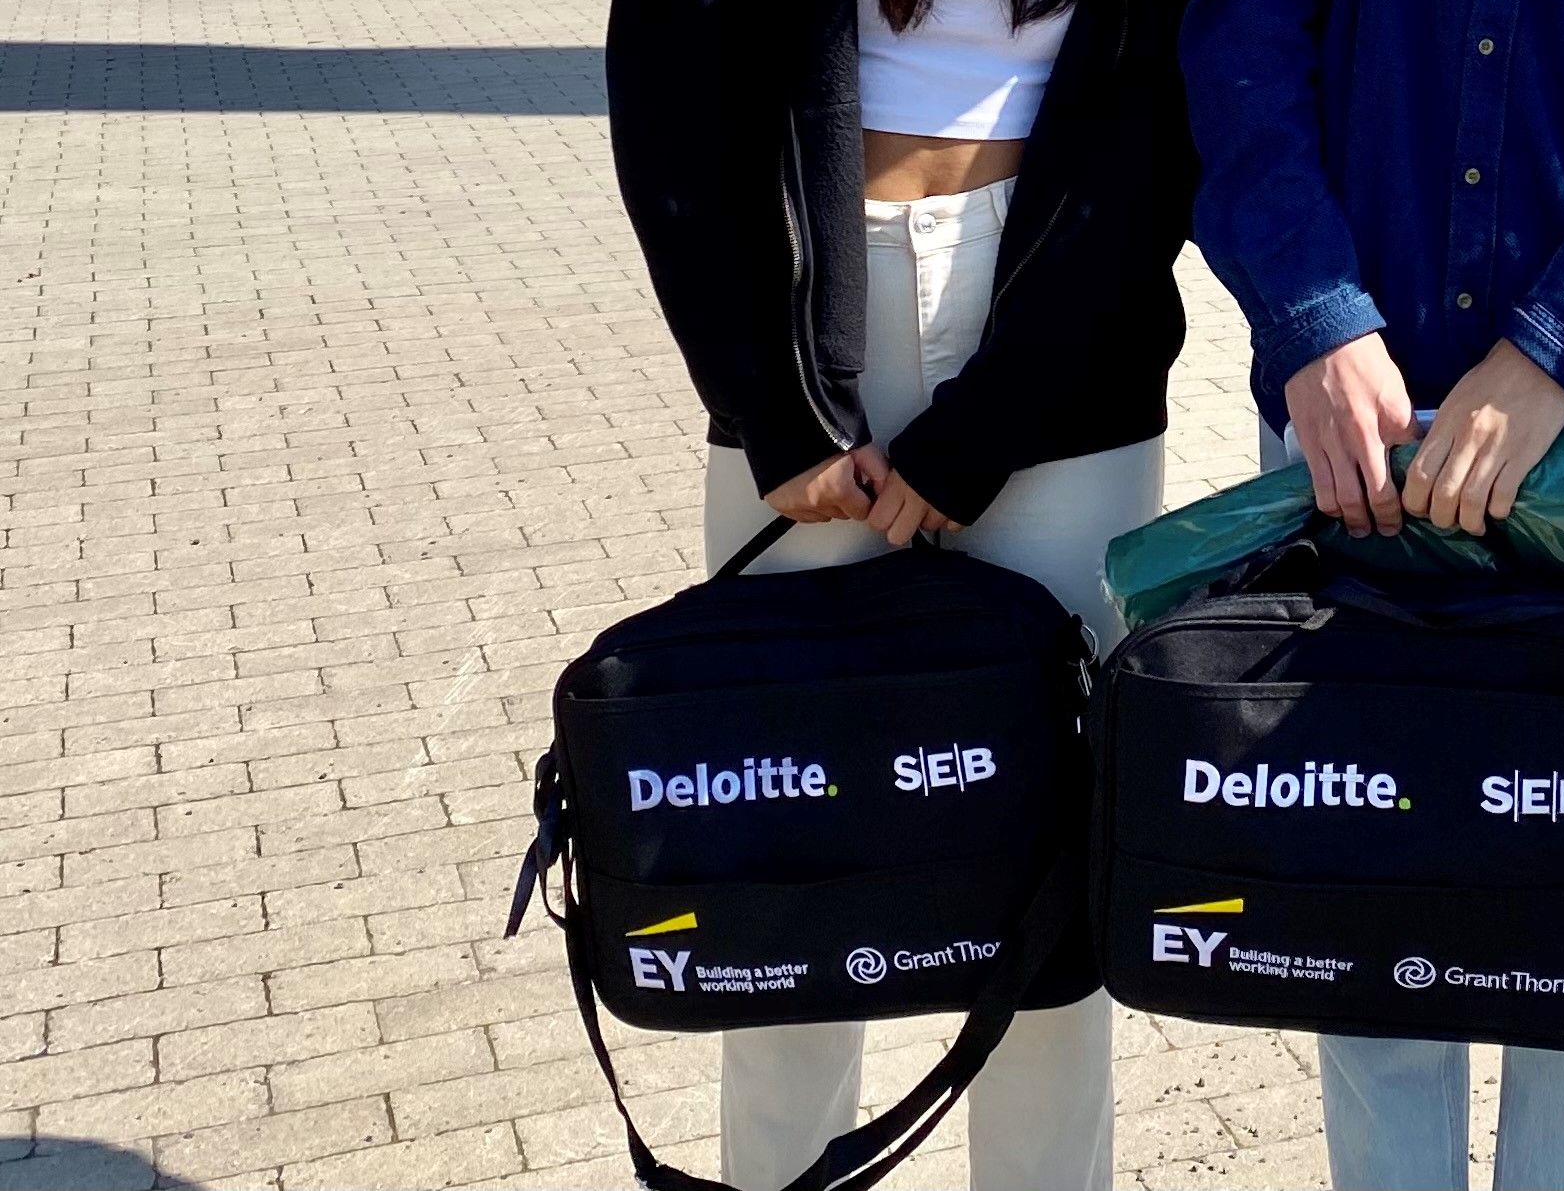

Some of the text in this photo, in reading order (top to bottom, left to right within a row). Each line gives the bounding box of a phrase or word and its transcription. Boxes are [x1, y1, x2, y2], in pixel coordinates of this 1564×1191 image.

[628, 757, 839, 811] Deloitte.
[1183, 759, 1412, 809] Deloitte.
[1153, 923, 1229, 968] EY
[628, 947, 691, 992] EY
[893, 946, 956, 971] Grant
[1229, 947, 1354, 972] Building a better
[1229, 960, 1335, 981] working world
[695, 964, 809, 982] Building a better
[699, 976, 796, 993] working world
[1444, 966, 1509, 990] Grant
